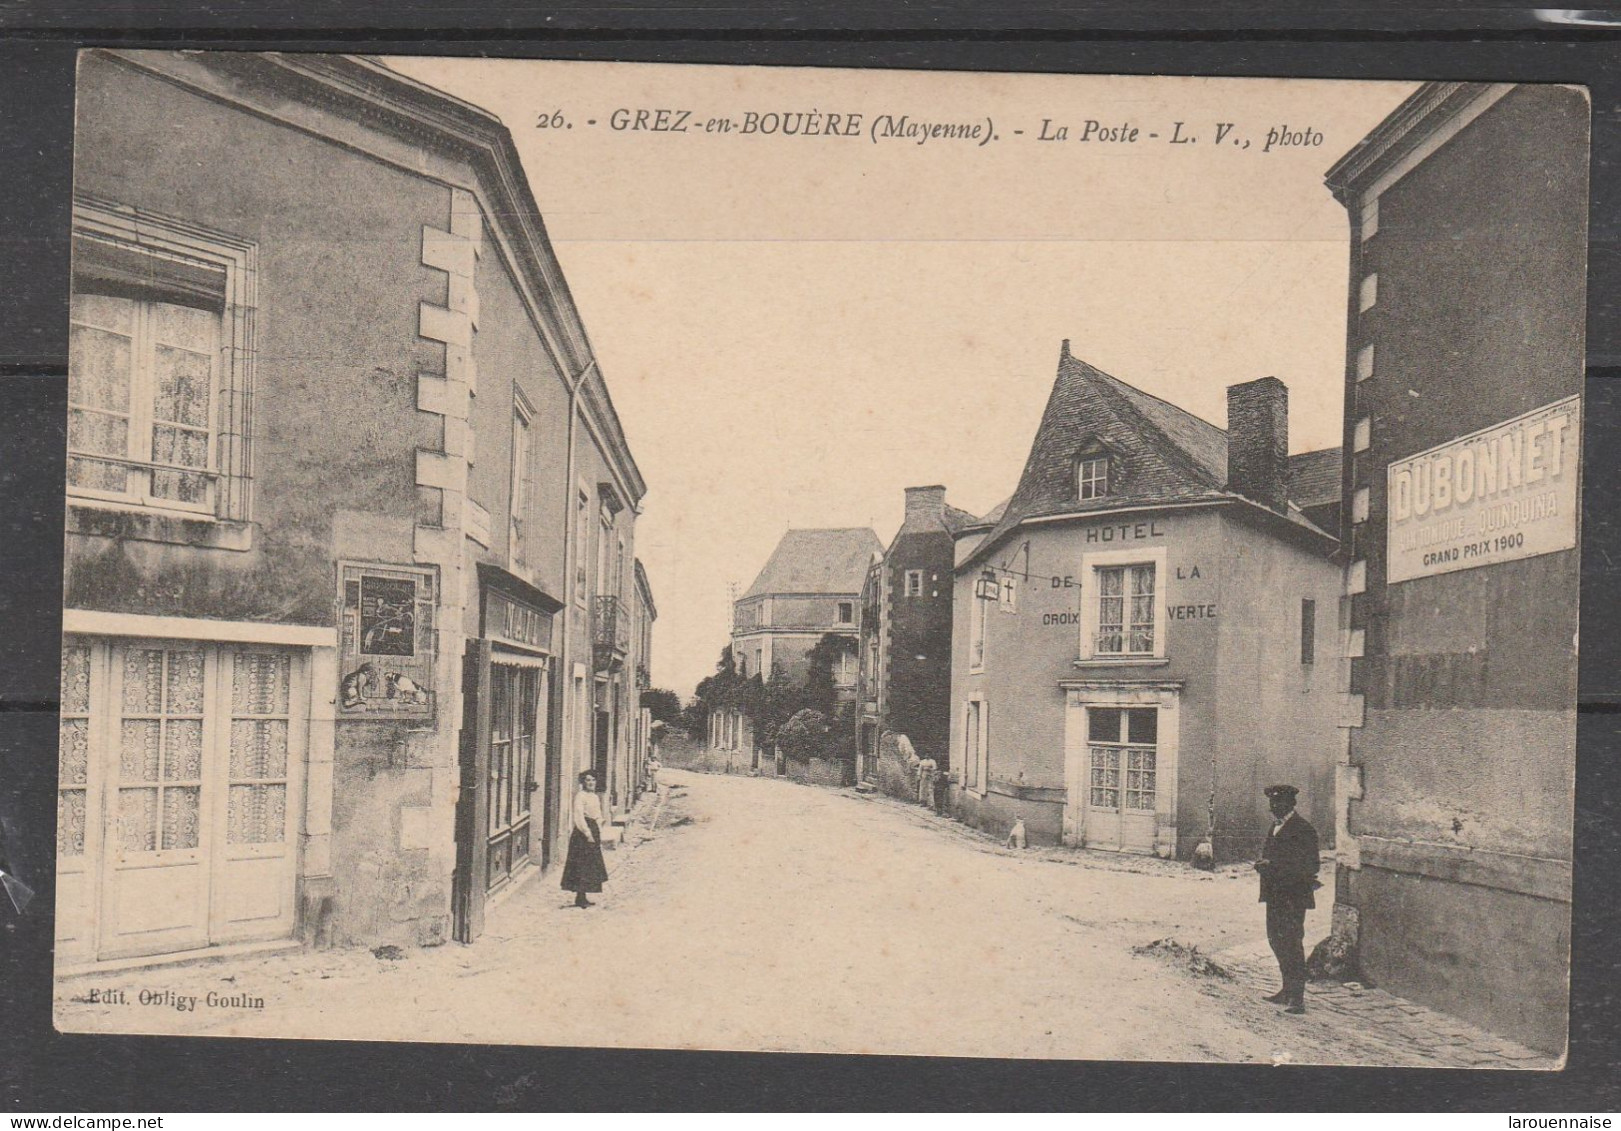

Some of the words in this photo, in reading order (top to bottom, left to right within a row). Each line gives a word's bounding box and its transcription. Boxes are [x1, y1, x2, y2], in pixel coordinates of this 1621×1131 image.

[1394, 414, 1570, 523] DUBONNET
[1479, 491, 1560, 537] QUINQUINA
[1086, 522, 1164, 543] HOTEL
[1423, 547, 1460, 567] GRAND
[1463, 541, 1490, 559] PRIX
[1494, 532, 1524, 551] 1900
[1177, 565, 1201, 580] LA
[1051, 575, 1074, 589] DE
[1043, 612, 1080, 626] CROIX
[1168, 604, 1217, 620] VERTE
